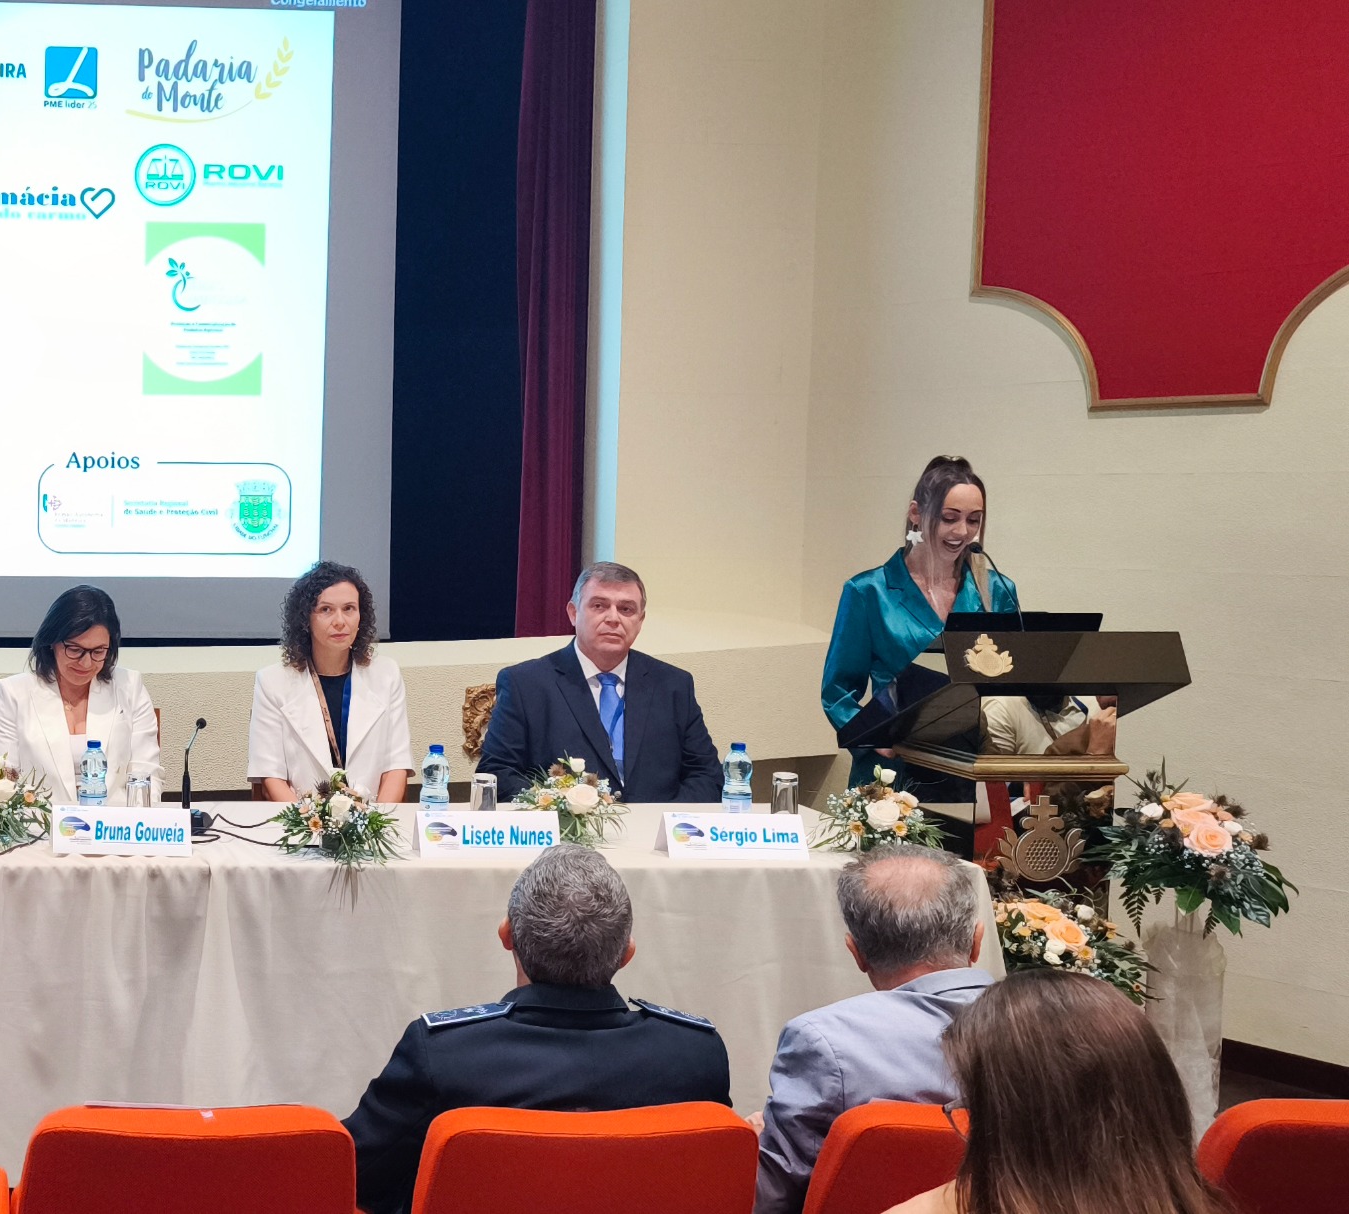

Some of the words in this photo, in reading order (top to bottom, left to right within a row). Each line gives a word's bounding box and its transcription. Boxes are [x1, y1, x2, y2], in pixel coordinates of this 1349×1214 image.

[138, 39, 258, 85] Padaria
[43, 100, 63, 108] PME
[156, 79, 224, 113] Monte
[203, 164, 284, 181] ROVI
[145, 181, 185, 190] ROVI
[65, 451, 140, 473] Apoios
[94, 820, 131, 840] Bruna
[135, 821, 184, 843] Gouveia
[462, 825, 505, 846] Lisete
[509, 825, 554, 846] Nunes
[709, 826, 758, 847] Sérgio
[762, 827, 799, 843] Lima
